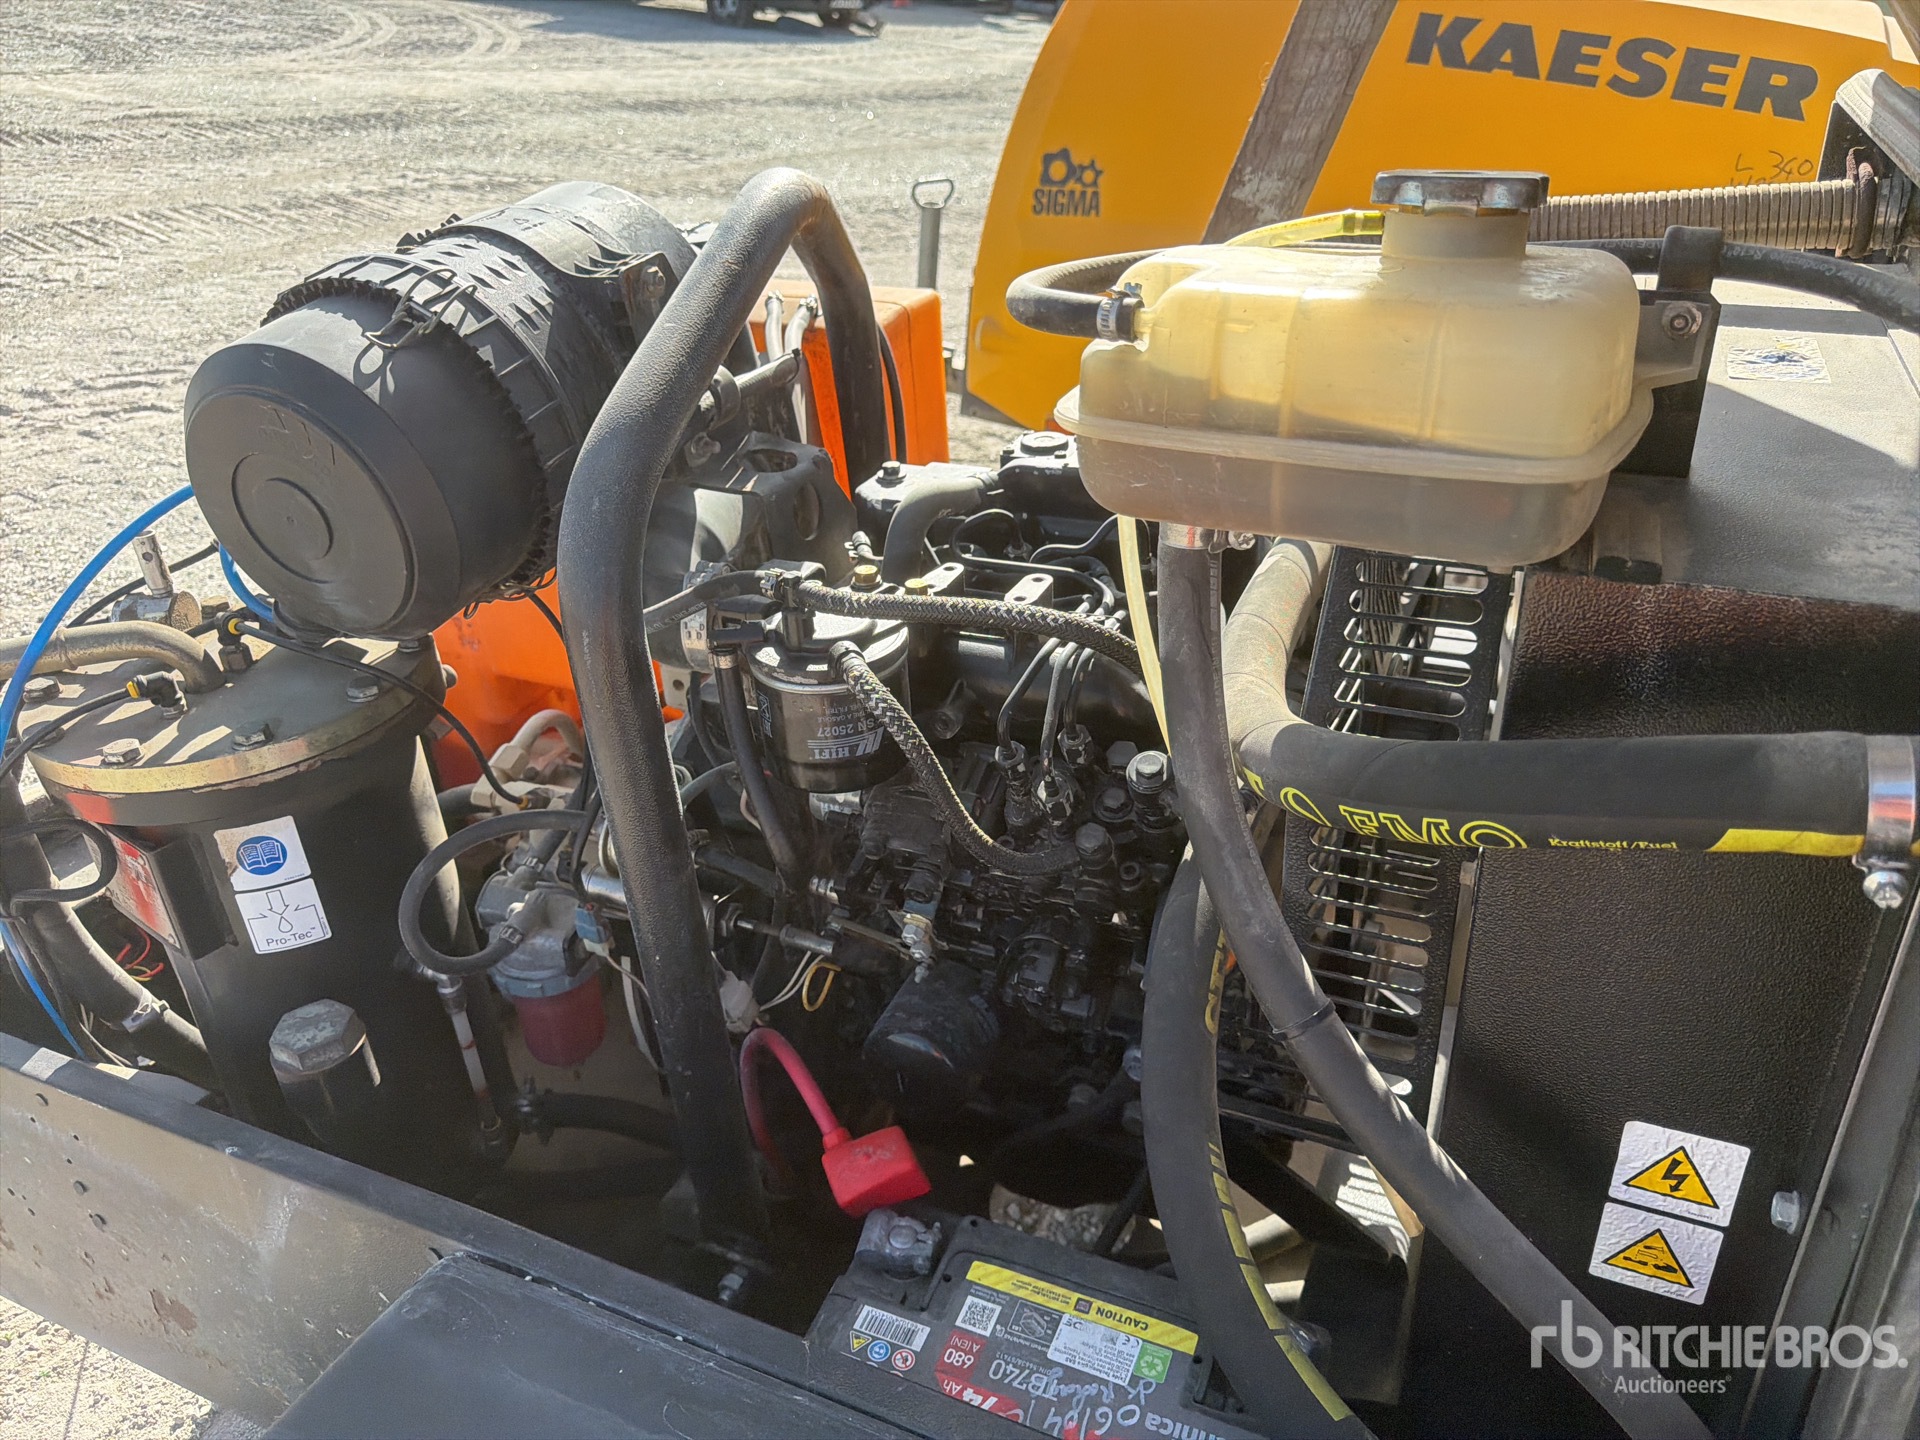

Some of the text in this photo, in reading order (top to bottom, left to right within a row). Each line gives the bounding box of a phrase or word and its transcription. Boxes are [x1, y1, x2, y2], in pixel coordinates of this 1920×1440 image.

[1407, 13, 1817, 122] KAESER
[1033, 185, 1101, 218] SIGMA
[817, 718, 874, 735] SN 25027
[813, 747, 849, 758] HIFI
[1094, 1306, 1149, 1331] CAUTION
[949, 1333, 980, 1353] A (EN)
[943, 1346, 974, 1370] 680
[942, 1378, 962, 1395] Ah
[987, 1358, 1057, 1401] TB740
